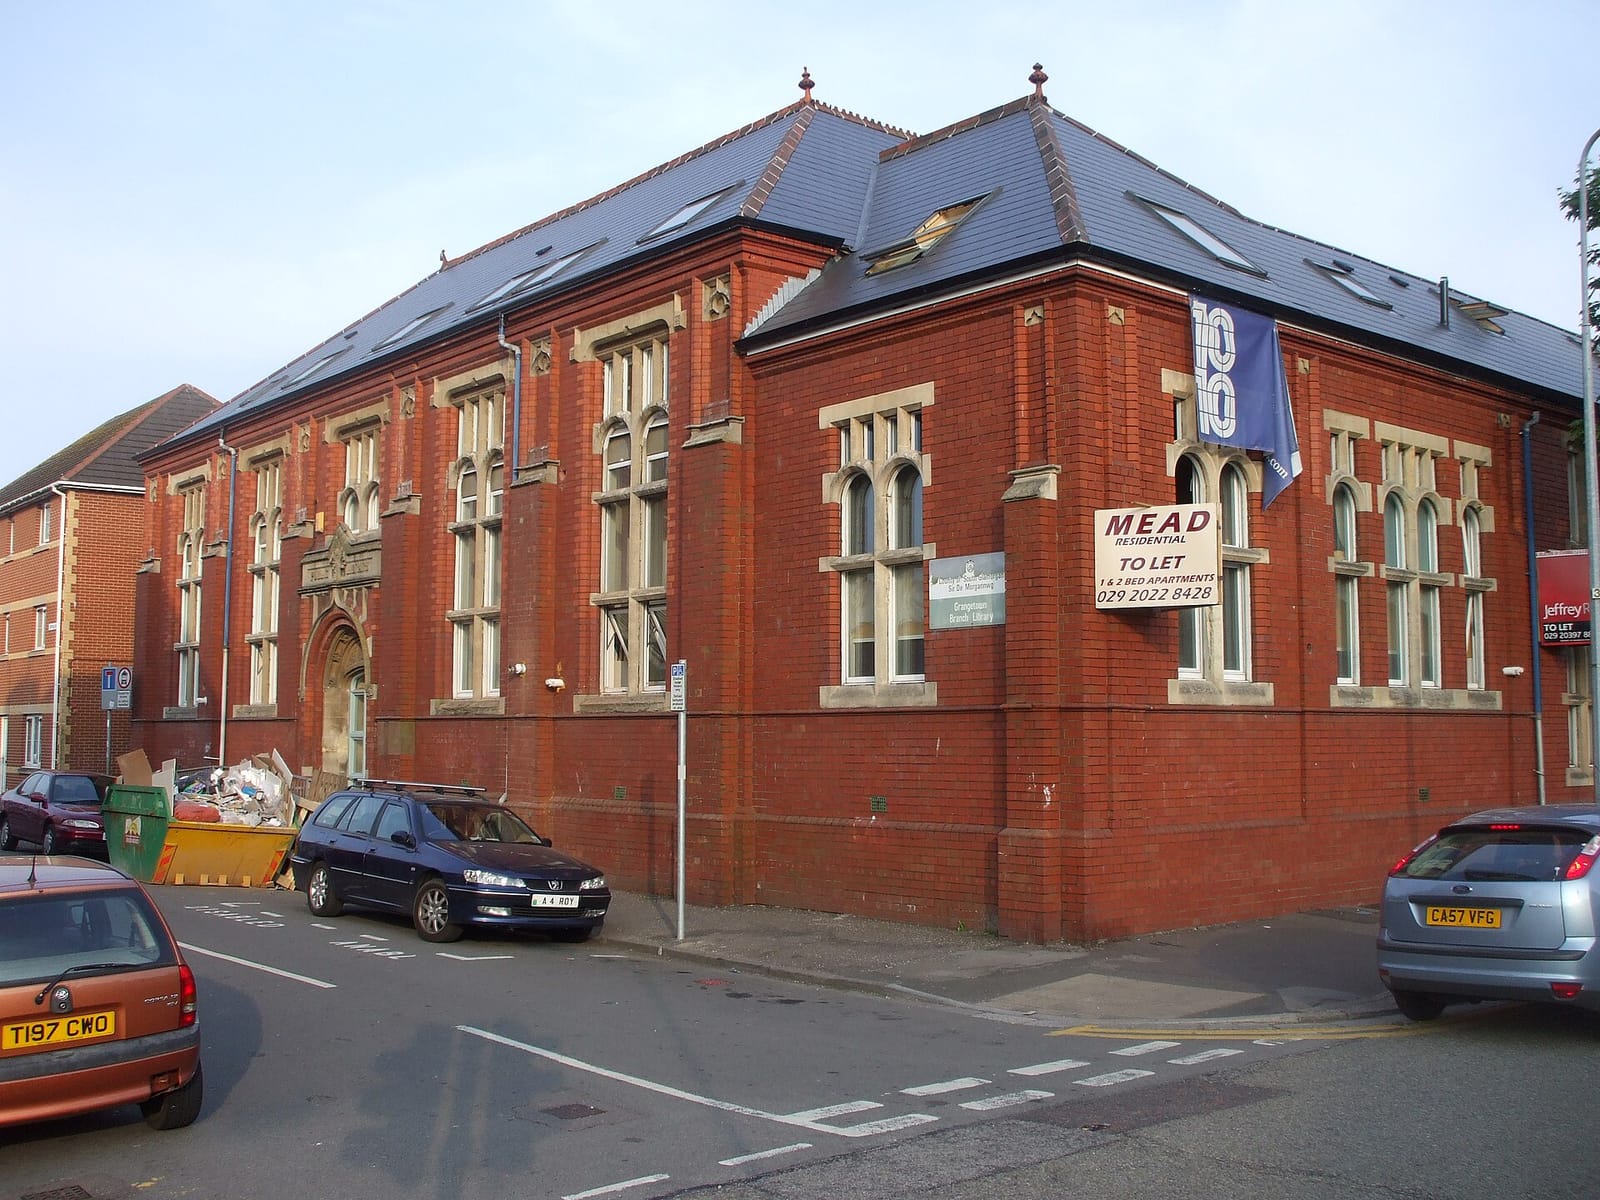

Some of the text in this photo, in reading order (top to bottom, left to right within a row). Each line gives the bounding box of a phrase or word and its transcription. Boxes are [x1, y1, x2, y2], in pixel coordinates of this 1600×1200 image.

[1105, 510, 1211, 536] MEAD
[1115, 535, 1186, 546] RESIDENTIAL
[1120, 555, 1185, 571] TO LET
[1107, 578, 1114, 586] &
[1116, 578, 1122, 586] 2
[1124, 577, 1145, 586] BED
[1146, 574, 1215, 585] APARTMENTS
[1097, 587, 1212, 603] 029 2022 8428
[954, 602, 987, 612] Grangetown
[1543, 603, 1582, 619] Jeffrey
[949, 612, 993, 623] Branch Library
[1543, 623, 1573, 632] TO LET
[1559, 631, 1582, 639] 20397
[559, 897, 574, 905] ROY
[1431, 909, 1494, 924] CA57 VFG
[11, 1015, 108, 1044] T197 CWO
